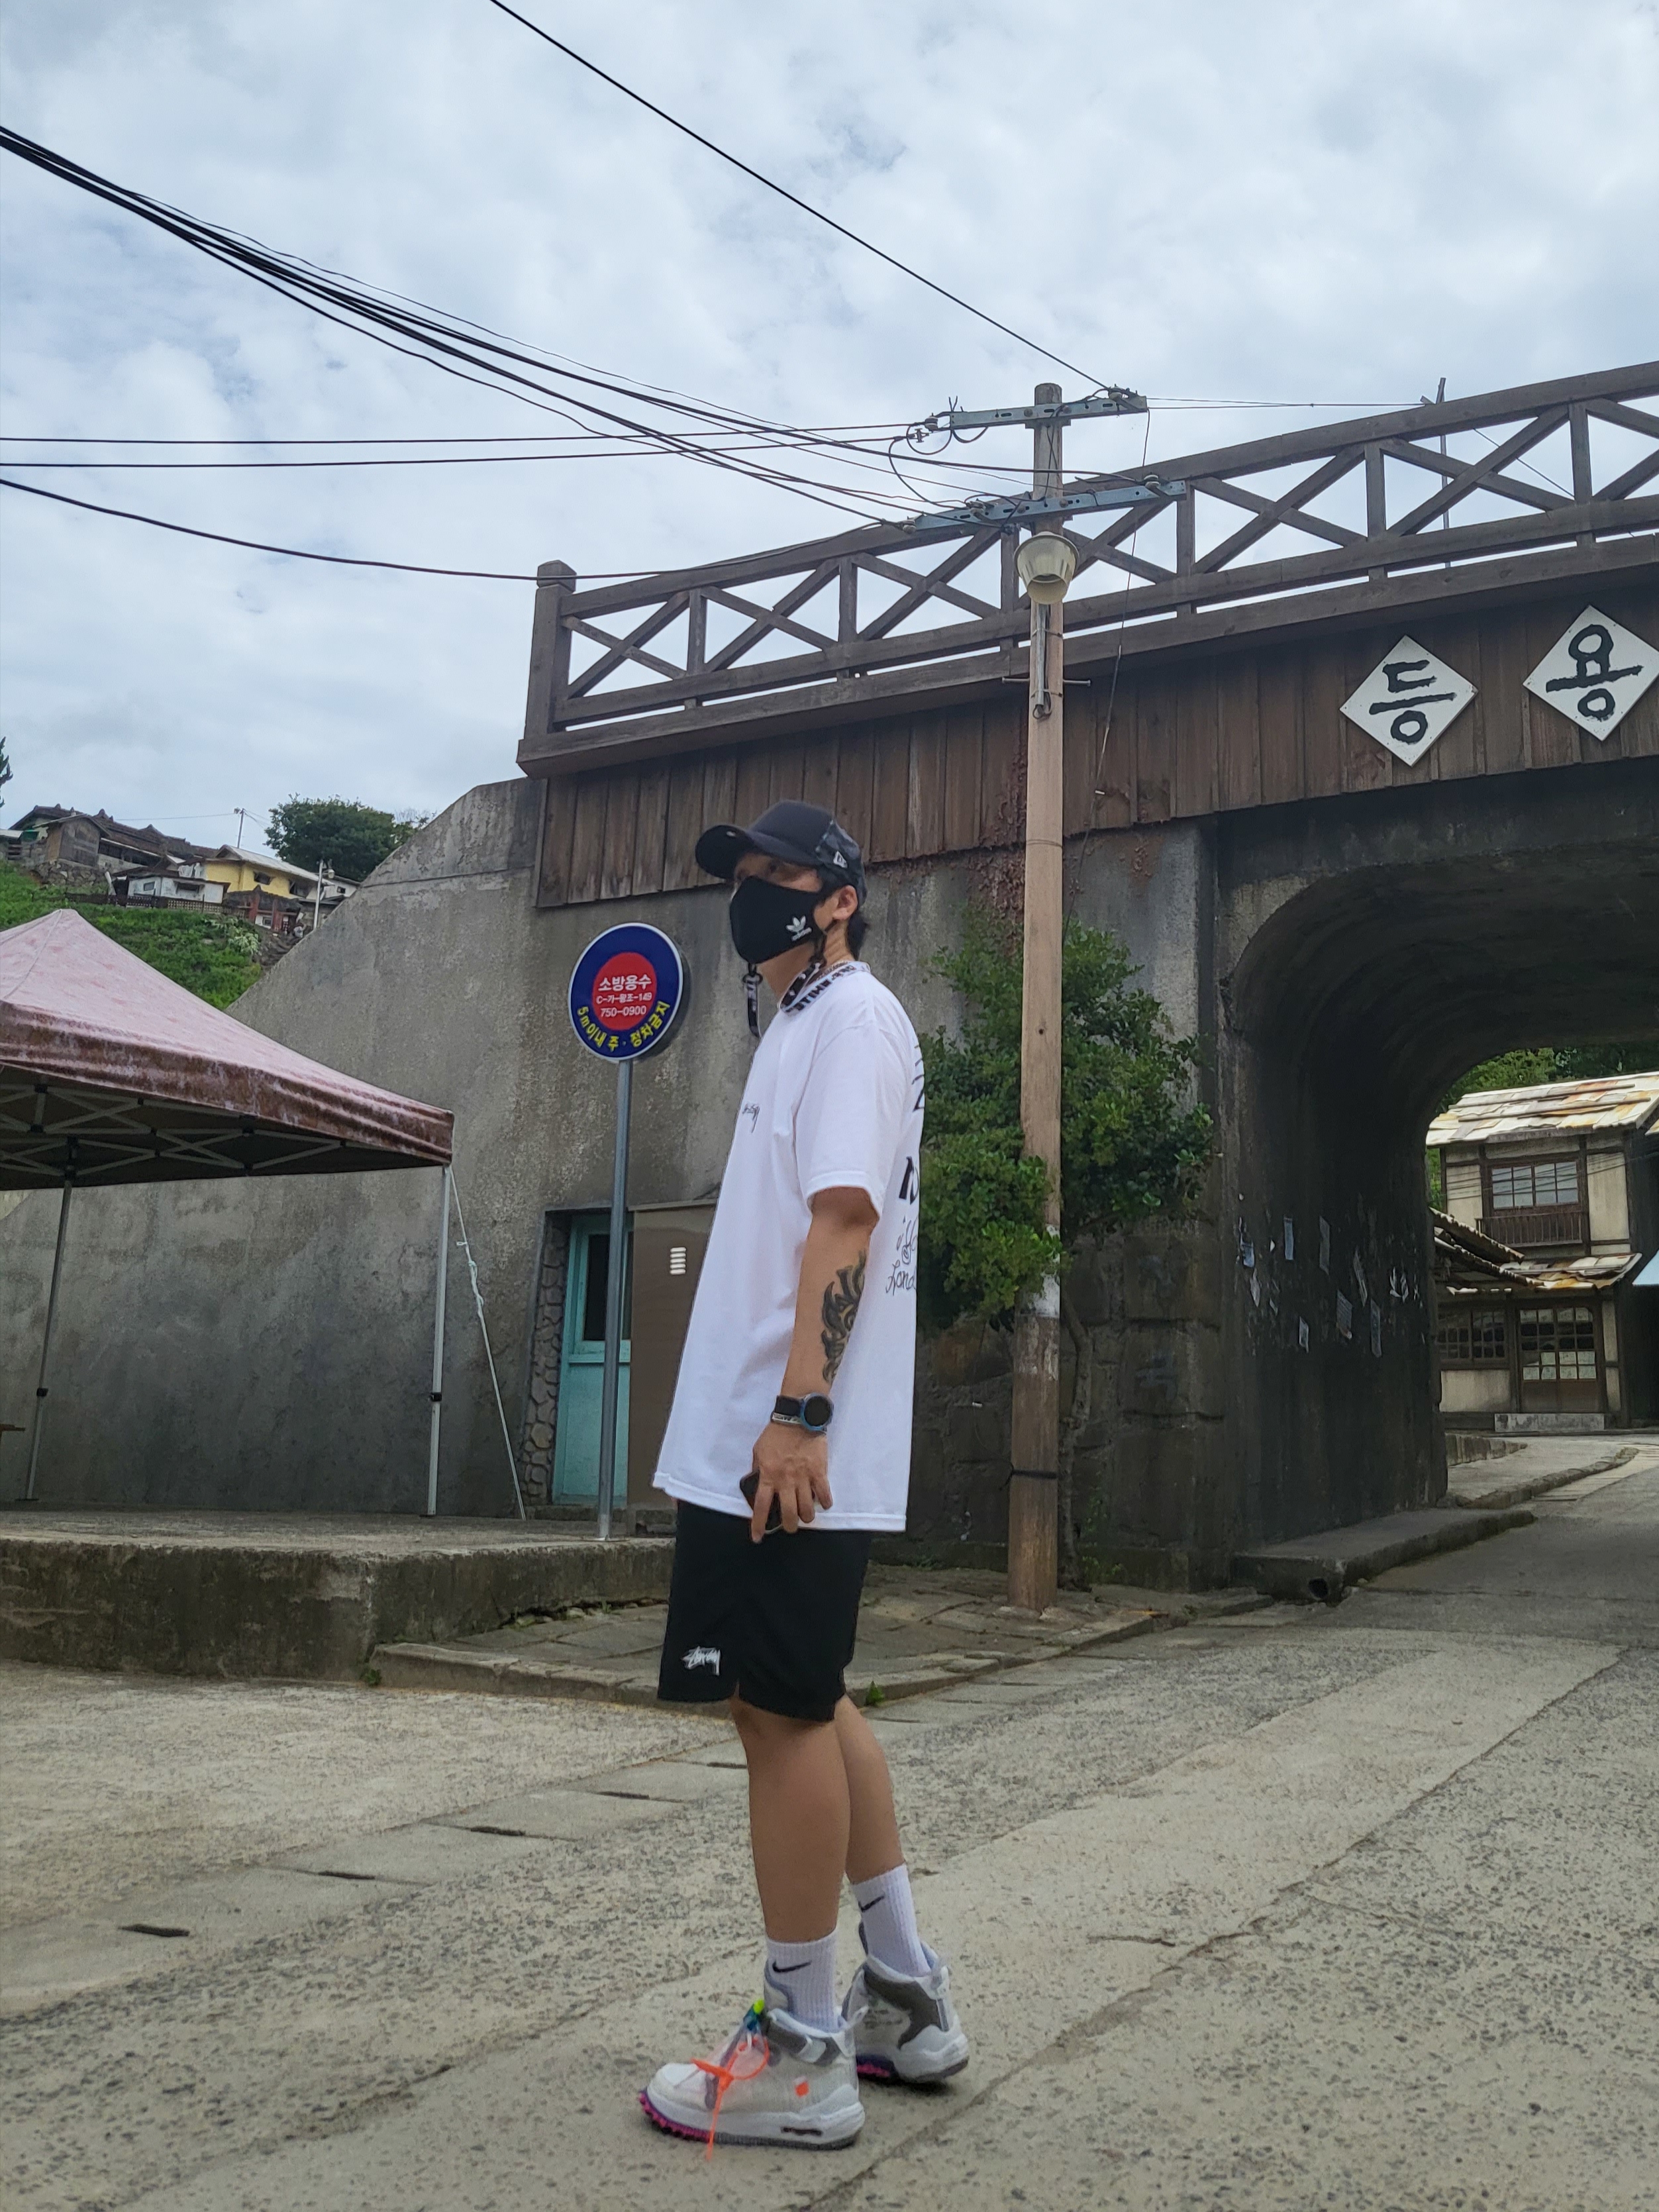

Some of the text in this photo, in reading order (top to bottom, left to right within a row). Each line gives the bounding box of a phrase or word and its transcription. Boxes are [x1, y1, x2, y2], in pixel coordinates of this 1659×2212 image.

[1369, 623, 1644, 744] 등 용
[599, 974, 652, 991] 소방용수
[601, 1006, 646, 1017] 750-0900
